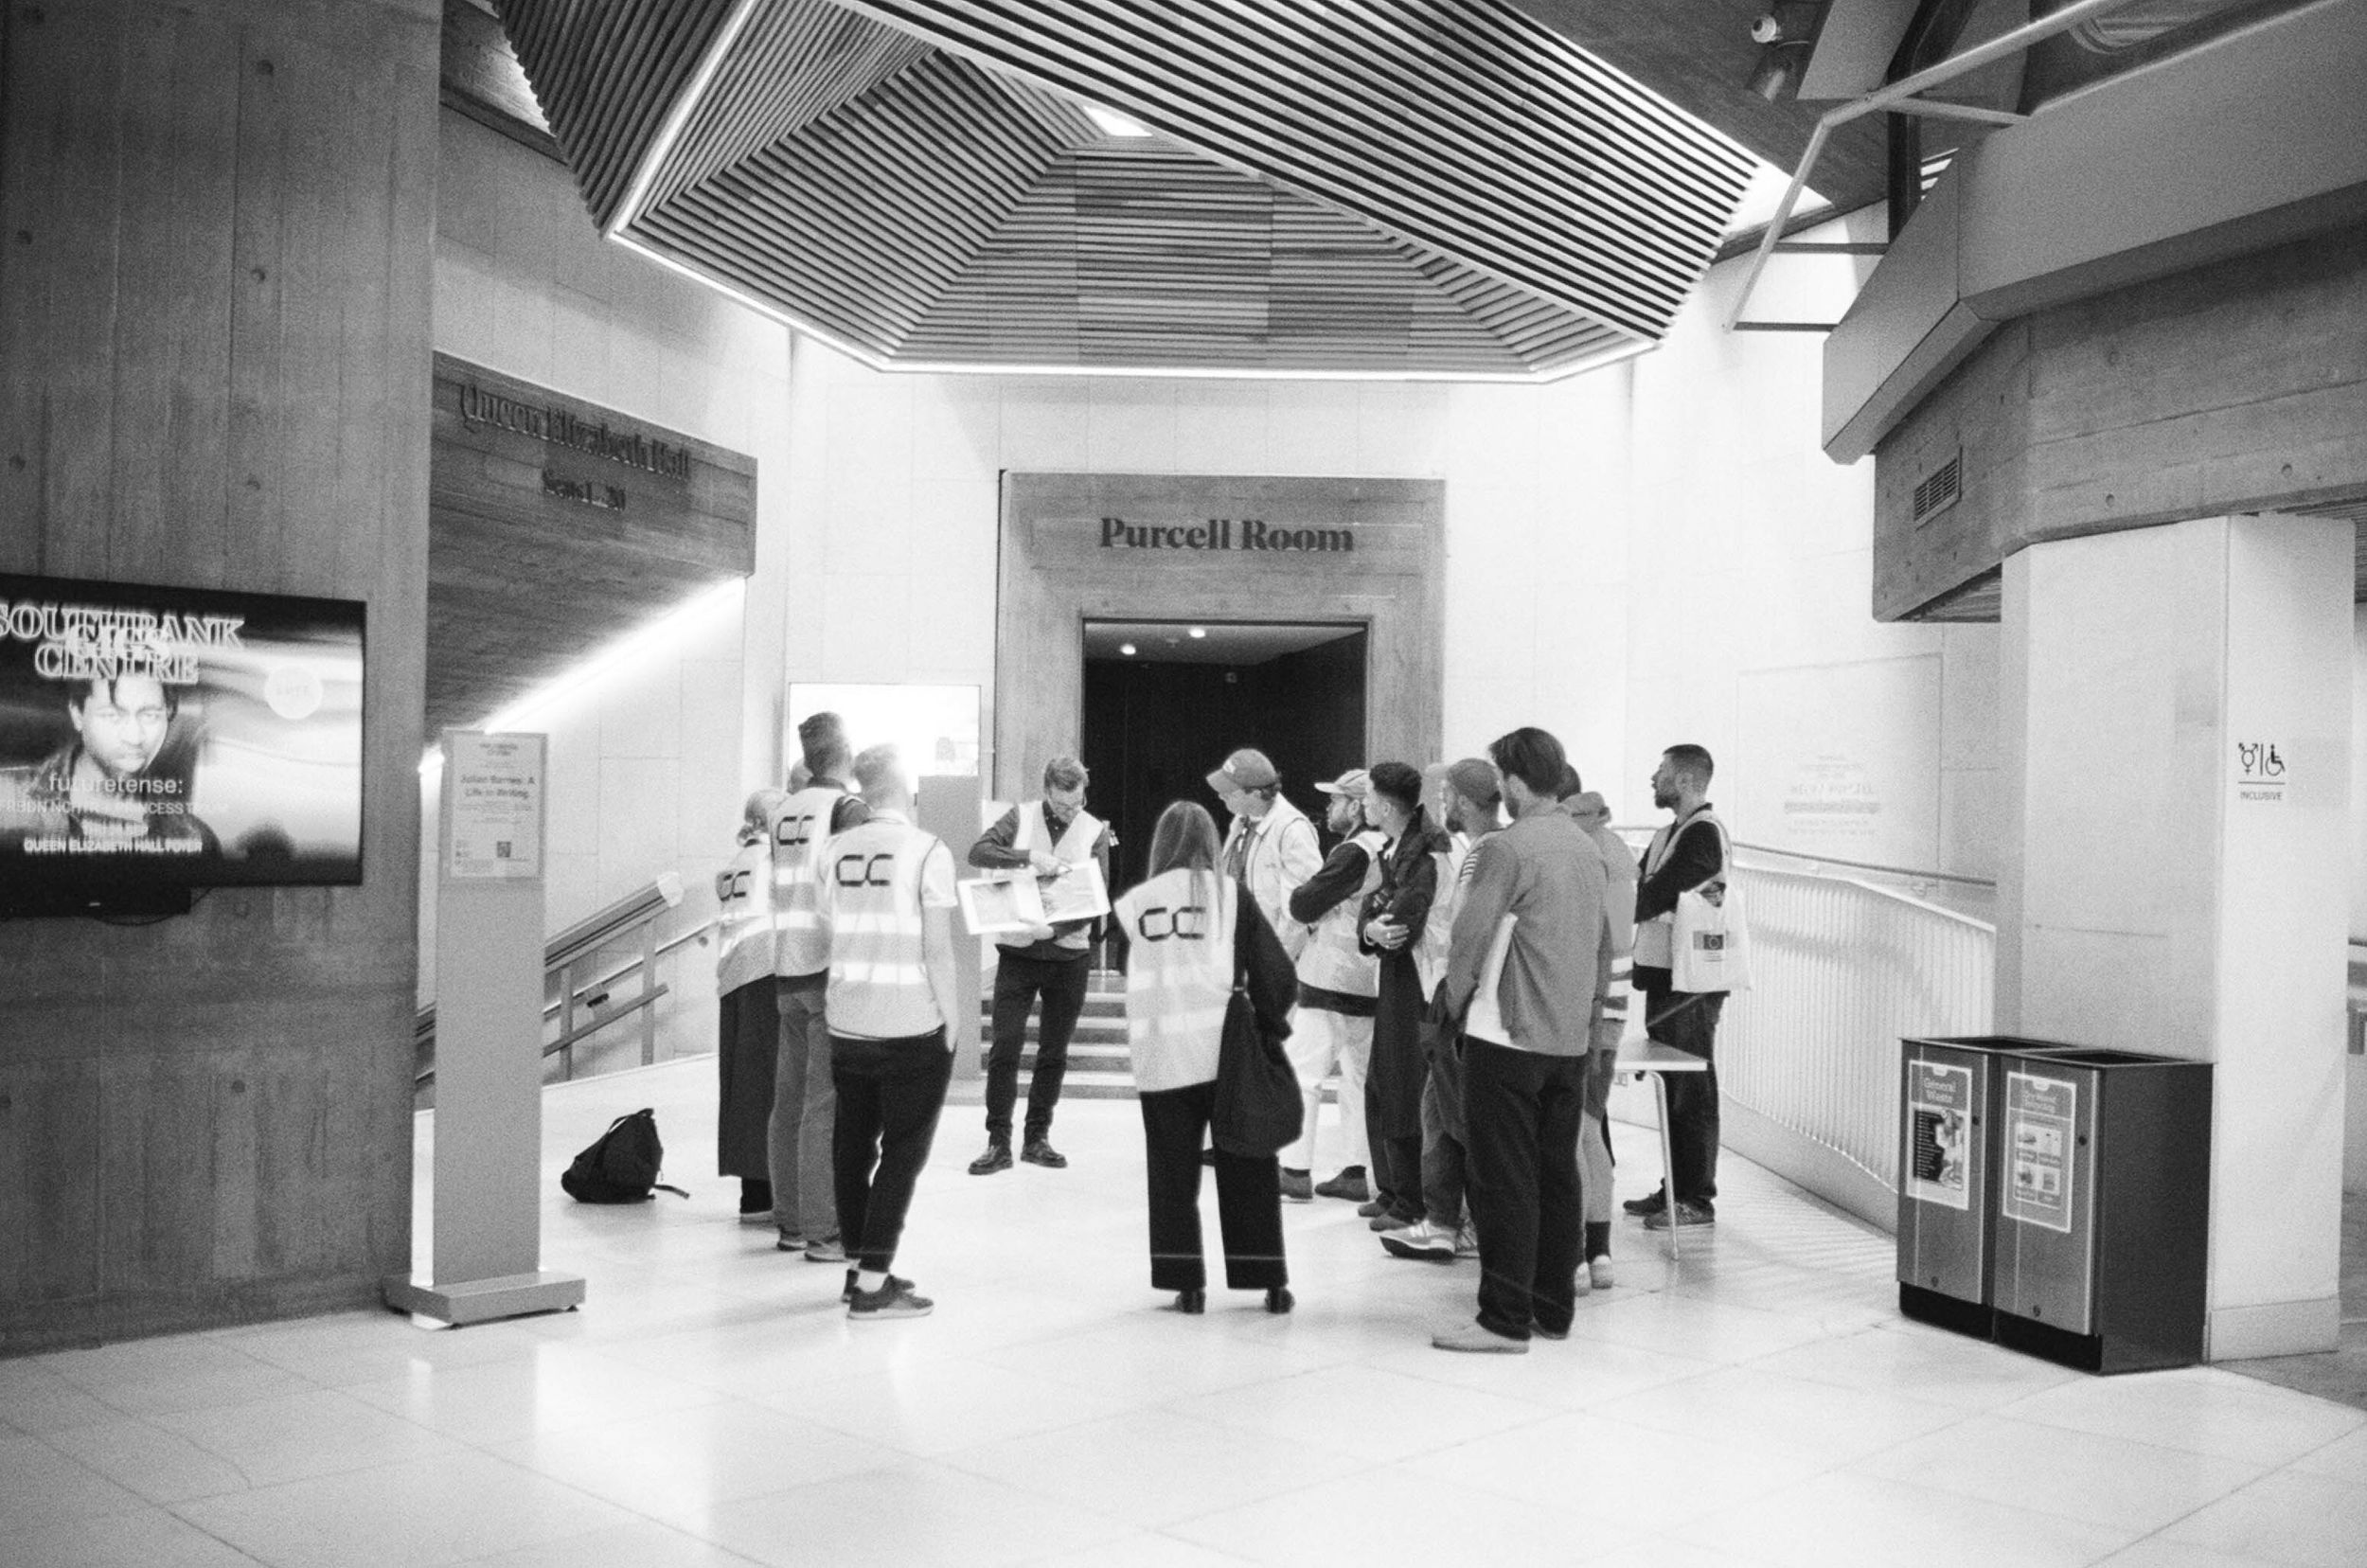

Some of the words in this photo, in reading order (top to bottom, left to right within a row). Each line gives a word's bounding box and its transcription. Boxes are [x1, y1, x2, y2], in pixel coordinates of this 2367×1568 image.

[460, 383, 541, 435] Queen
[544, 405, 646, 468] Elizabeth
[650, 437, 691, 482] Hall
[1101, 517, 1230, 549] Purcell
[1241, 520, 1354, 551] Room
[0, 602, 244, 650] SOUTHBANK
[35, 642, 200, 685] CENTRE
[24, 836, 65, 852] QUEEN
[69, 836, 131, 853] ELIZABETH
[134, 836, 164, 852] HALL
